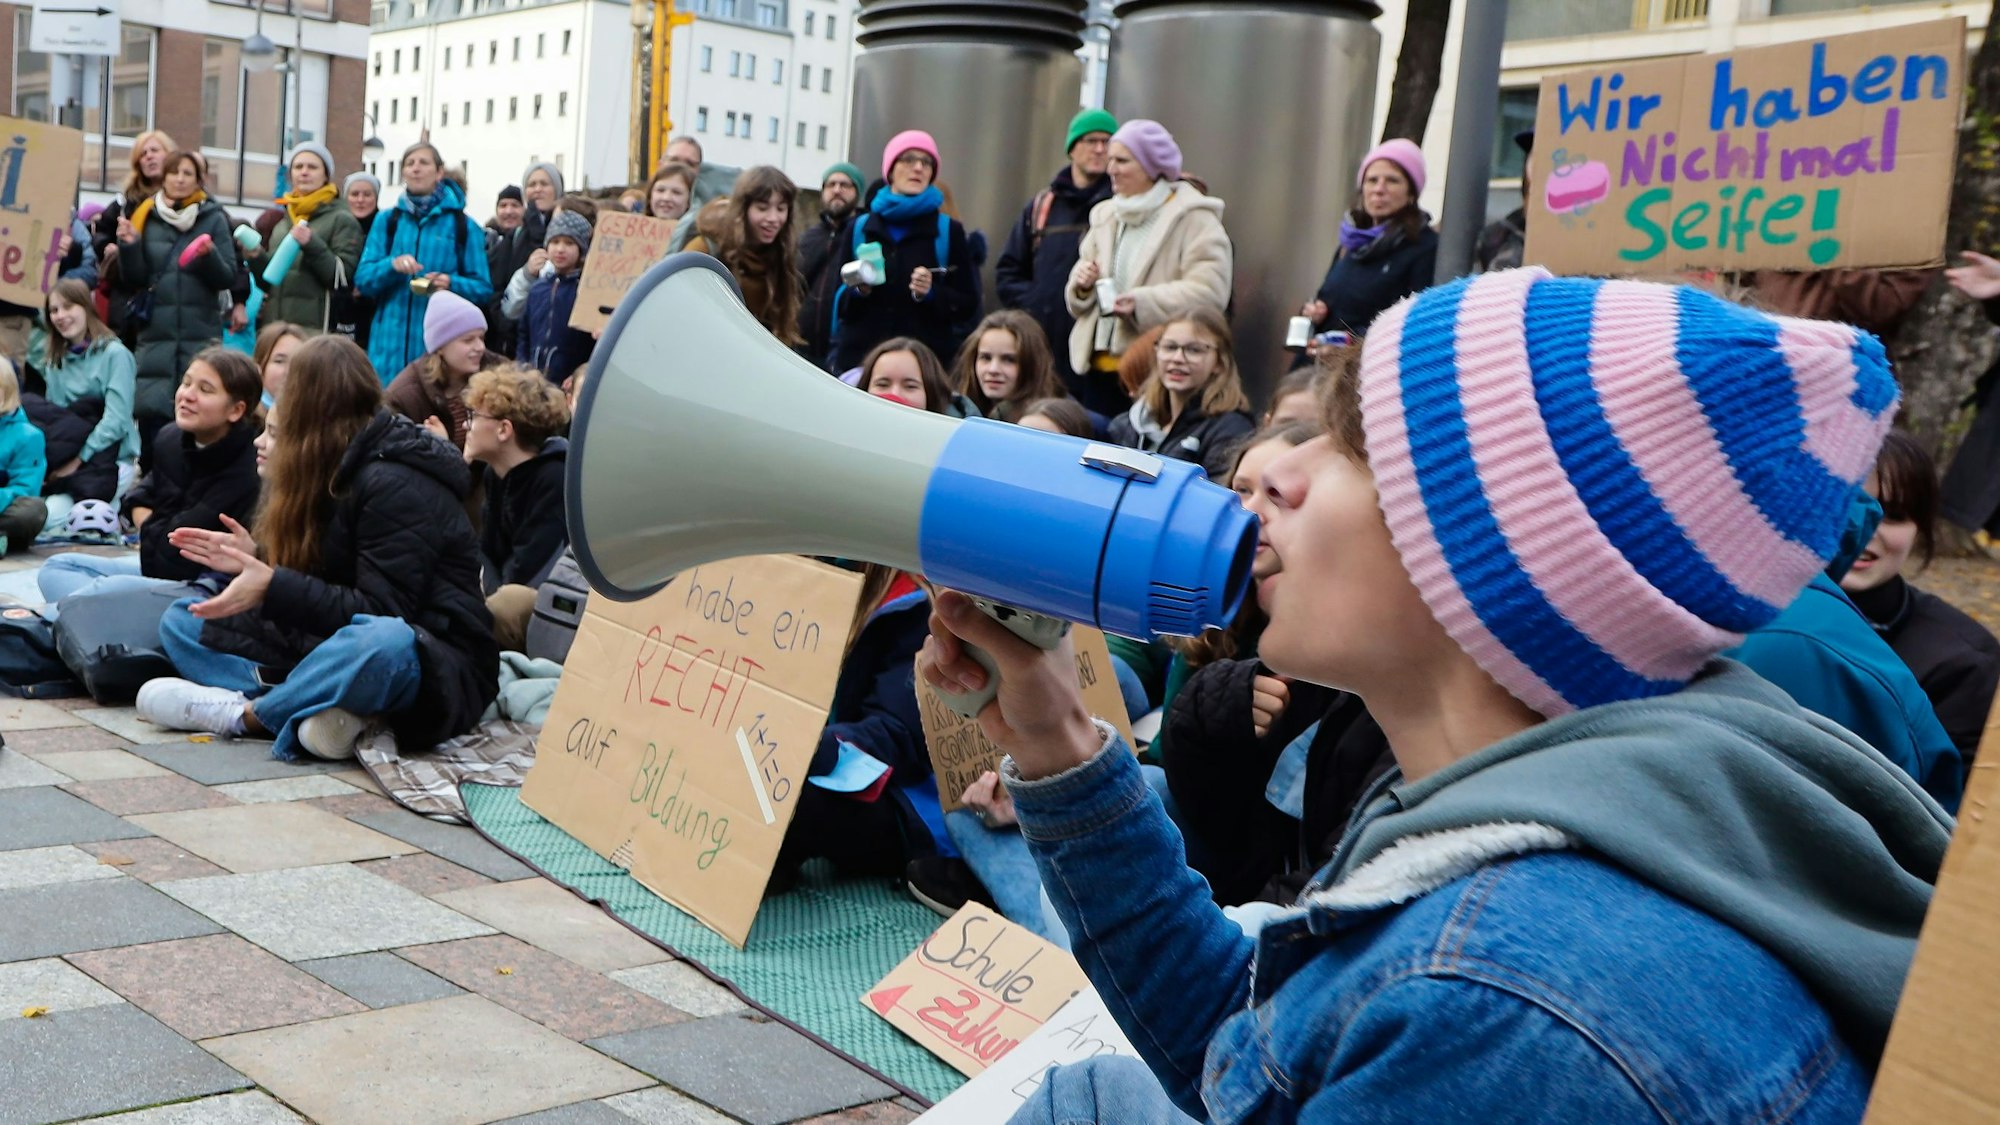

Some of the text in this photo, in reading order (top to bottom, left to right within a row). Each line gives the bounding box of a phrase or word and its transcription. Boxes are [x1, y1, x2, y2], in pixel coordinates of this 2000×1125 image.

[1558, 42, 1948, 134] Wir haben
[1619, 186, 1841, 265] Seife!
[686, 568, 820, 653] habe ein
[624, 625, 765, 733] RECHT
[566, 718, 617, 769] auf
[629, 742, 732, 870] Bildung
[922, 915, 1044, 1004] Schule
